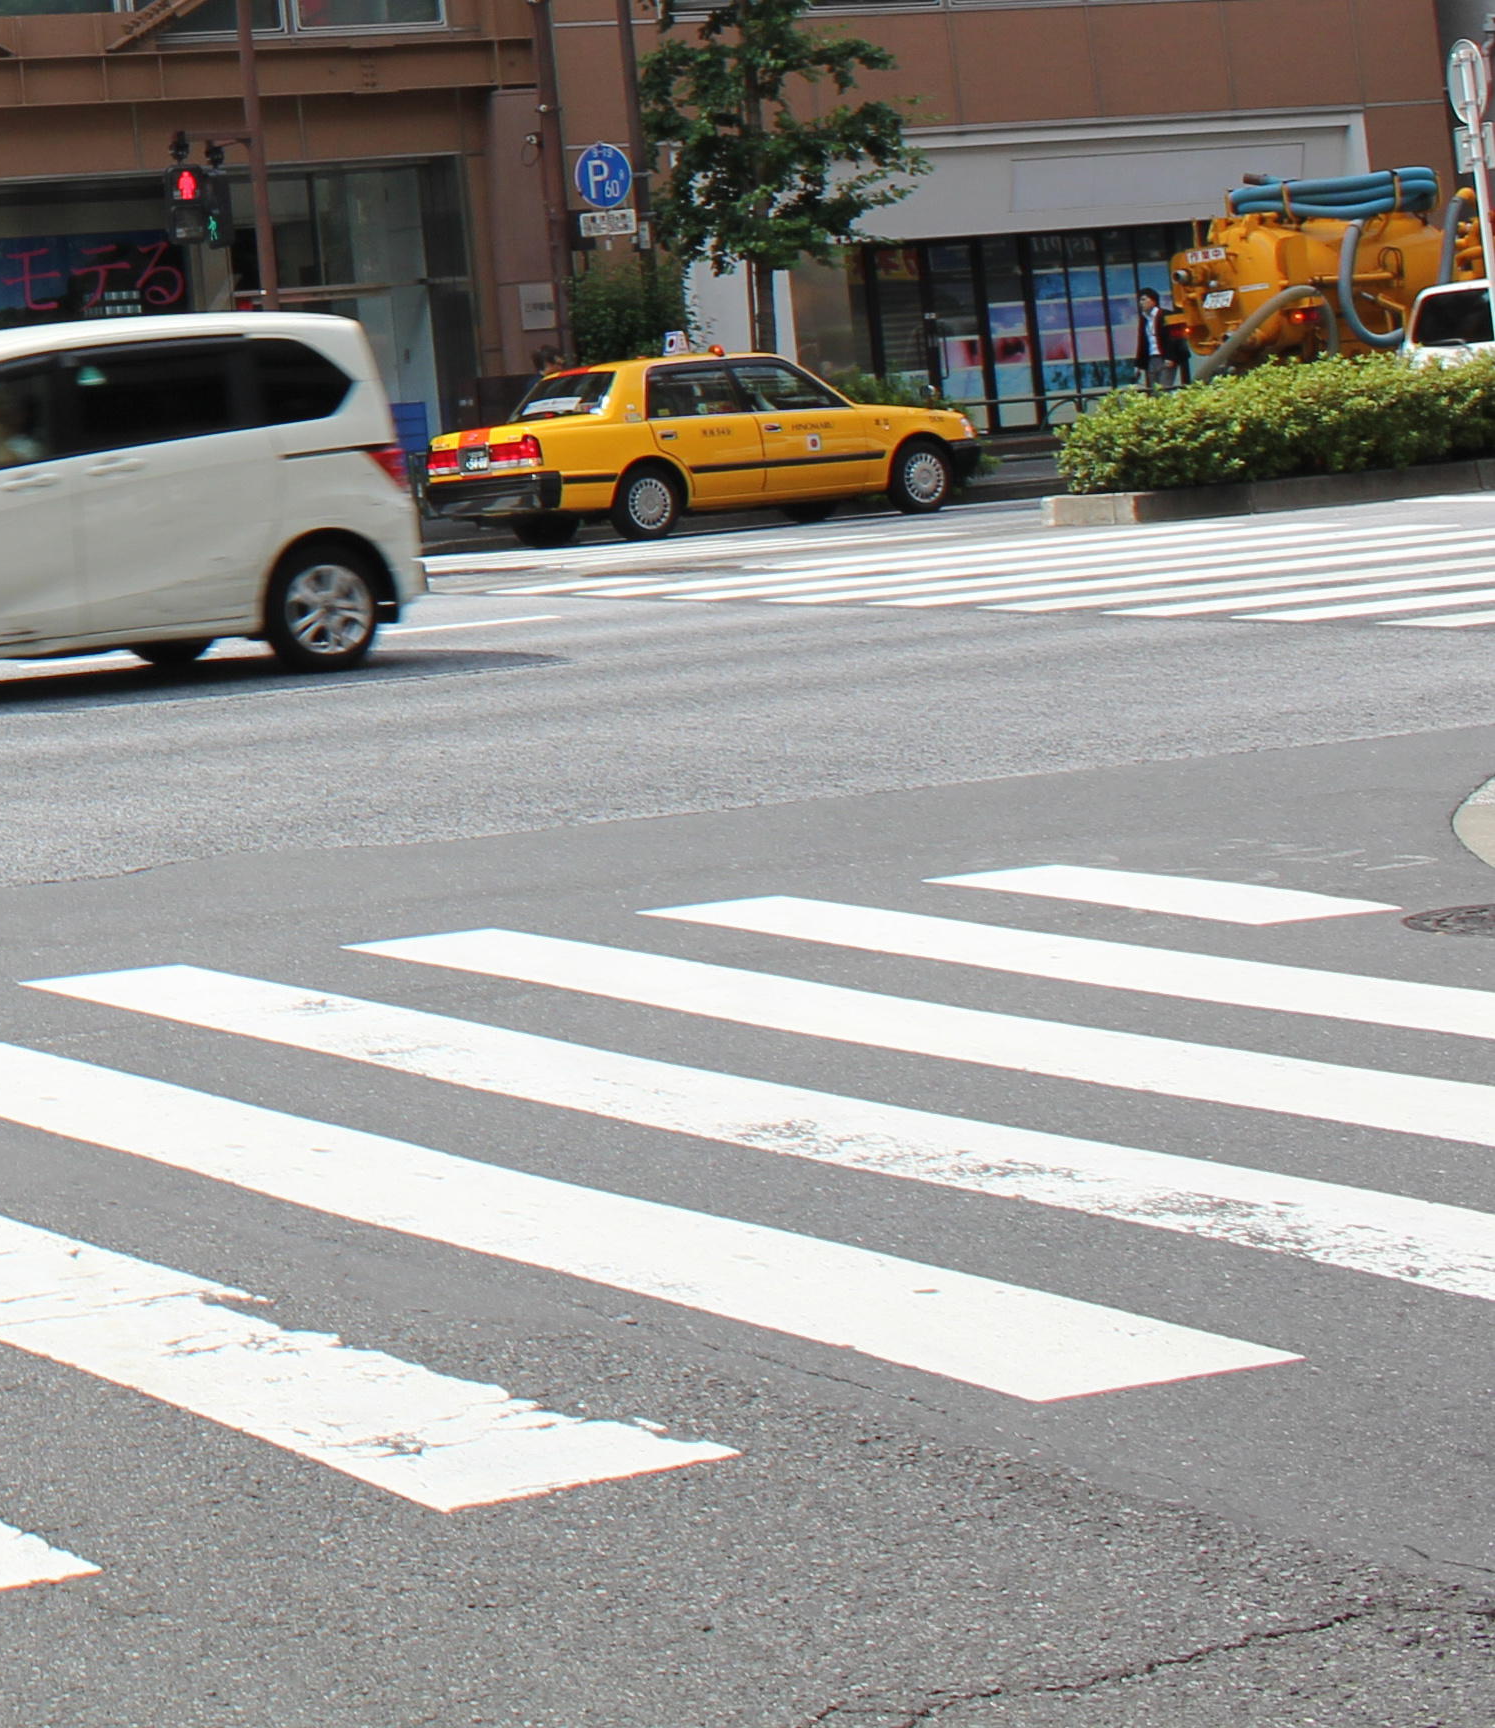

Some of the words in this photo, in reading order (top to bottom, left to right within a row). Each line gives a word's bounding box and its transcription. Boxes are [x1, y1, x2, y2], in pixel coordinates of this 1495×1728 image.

[586, 159, 609, 199] P
[604, 180, 620, 198] 60
[0, 241, 185, 311] モテる
